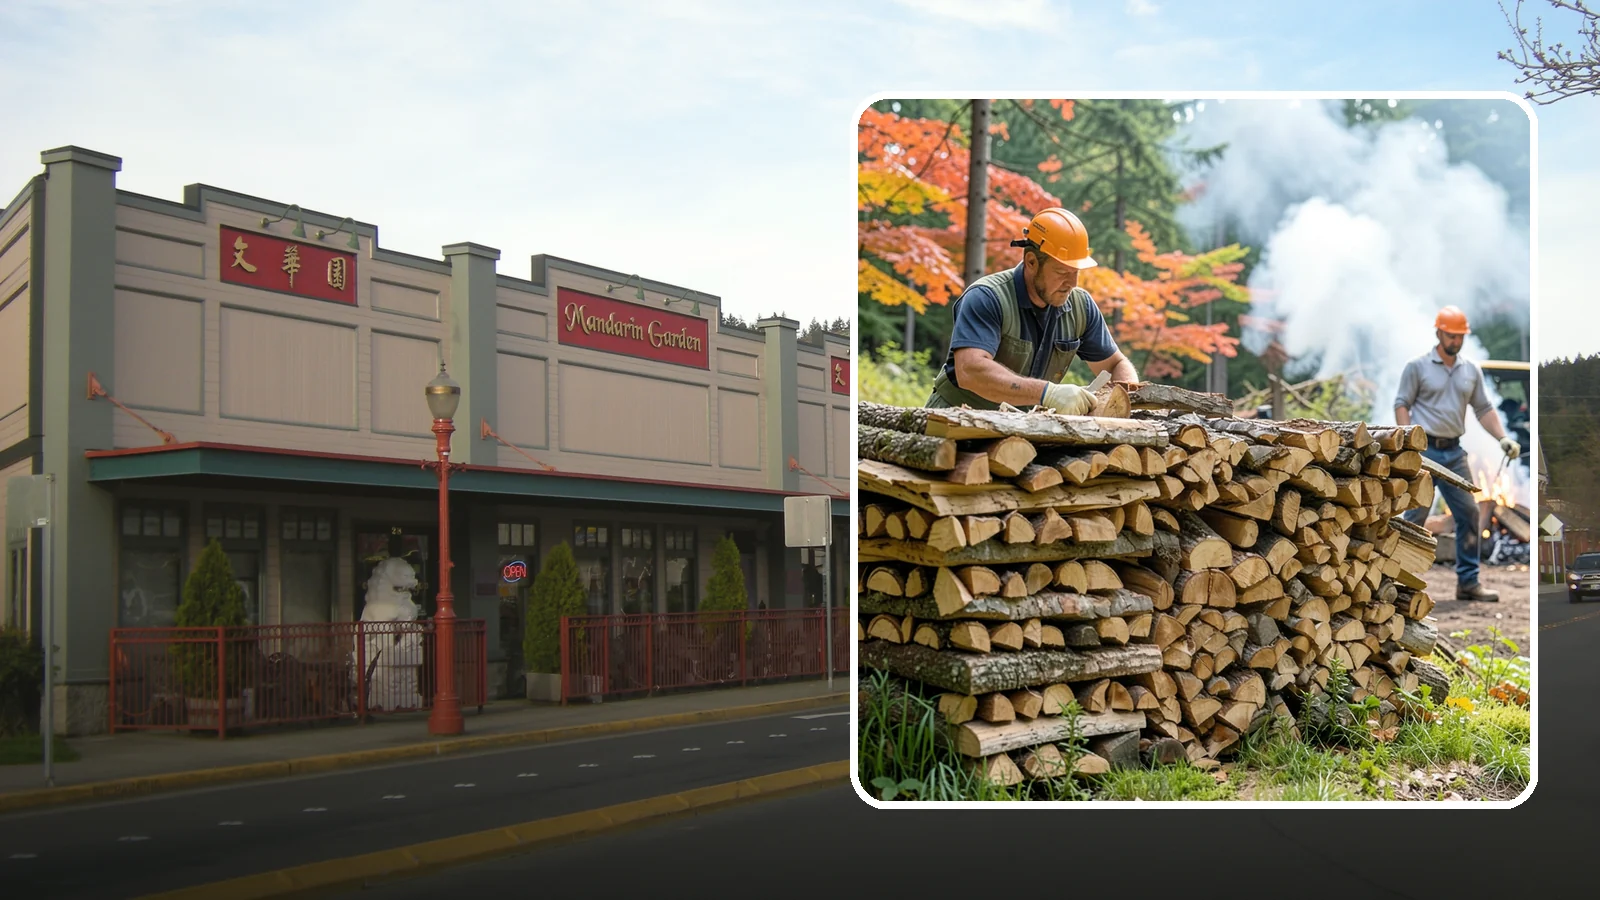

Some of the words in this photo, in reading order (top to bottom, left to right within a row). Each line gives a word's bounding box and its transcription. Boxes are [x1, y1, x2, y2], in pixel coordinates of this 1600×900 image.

[230, 235, 347, 291] 文華園
[564, 302, 644, 341] Mandarin
[647, 320, 702, 352] Garden
[834, 362, 847, 386] 文
[503, 565, 527, 578] OPEN
